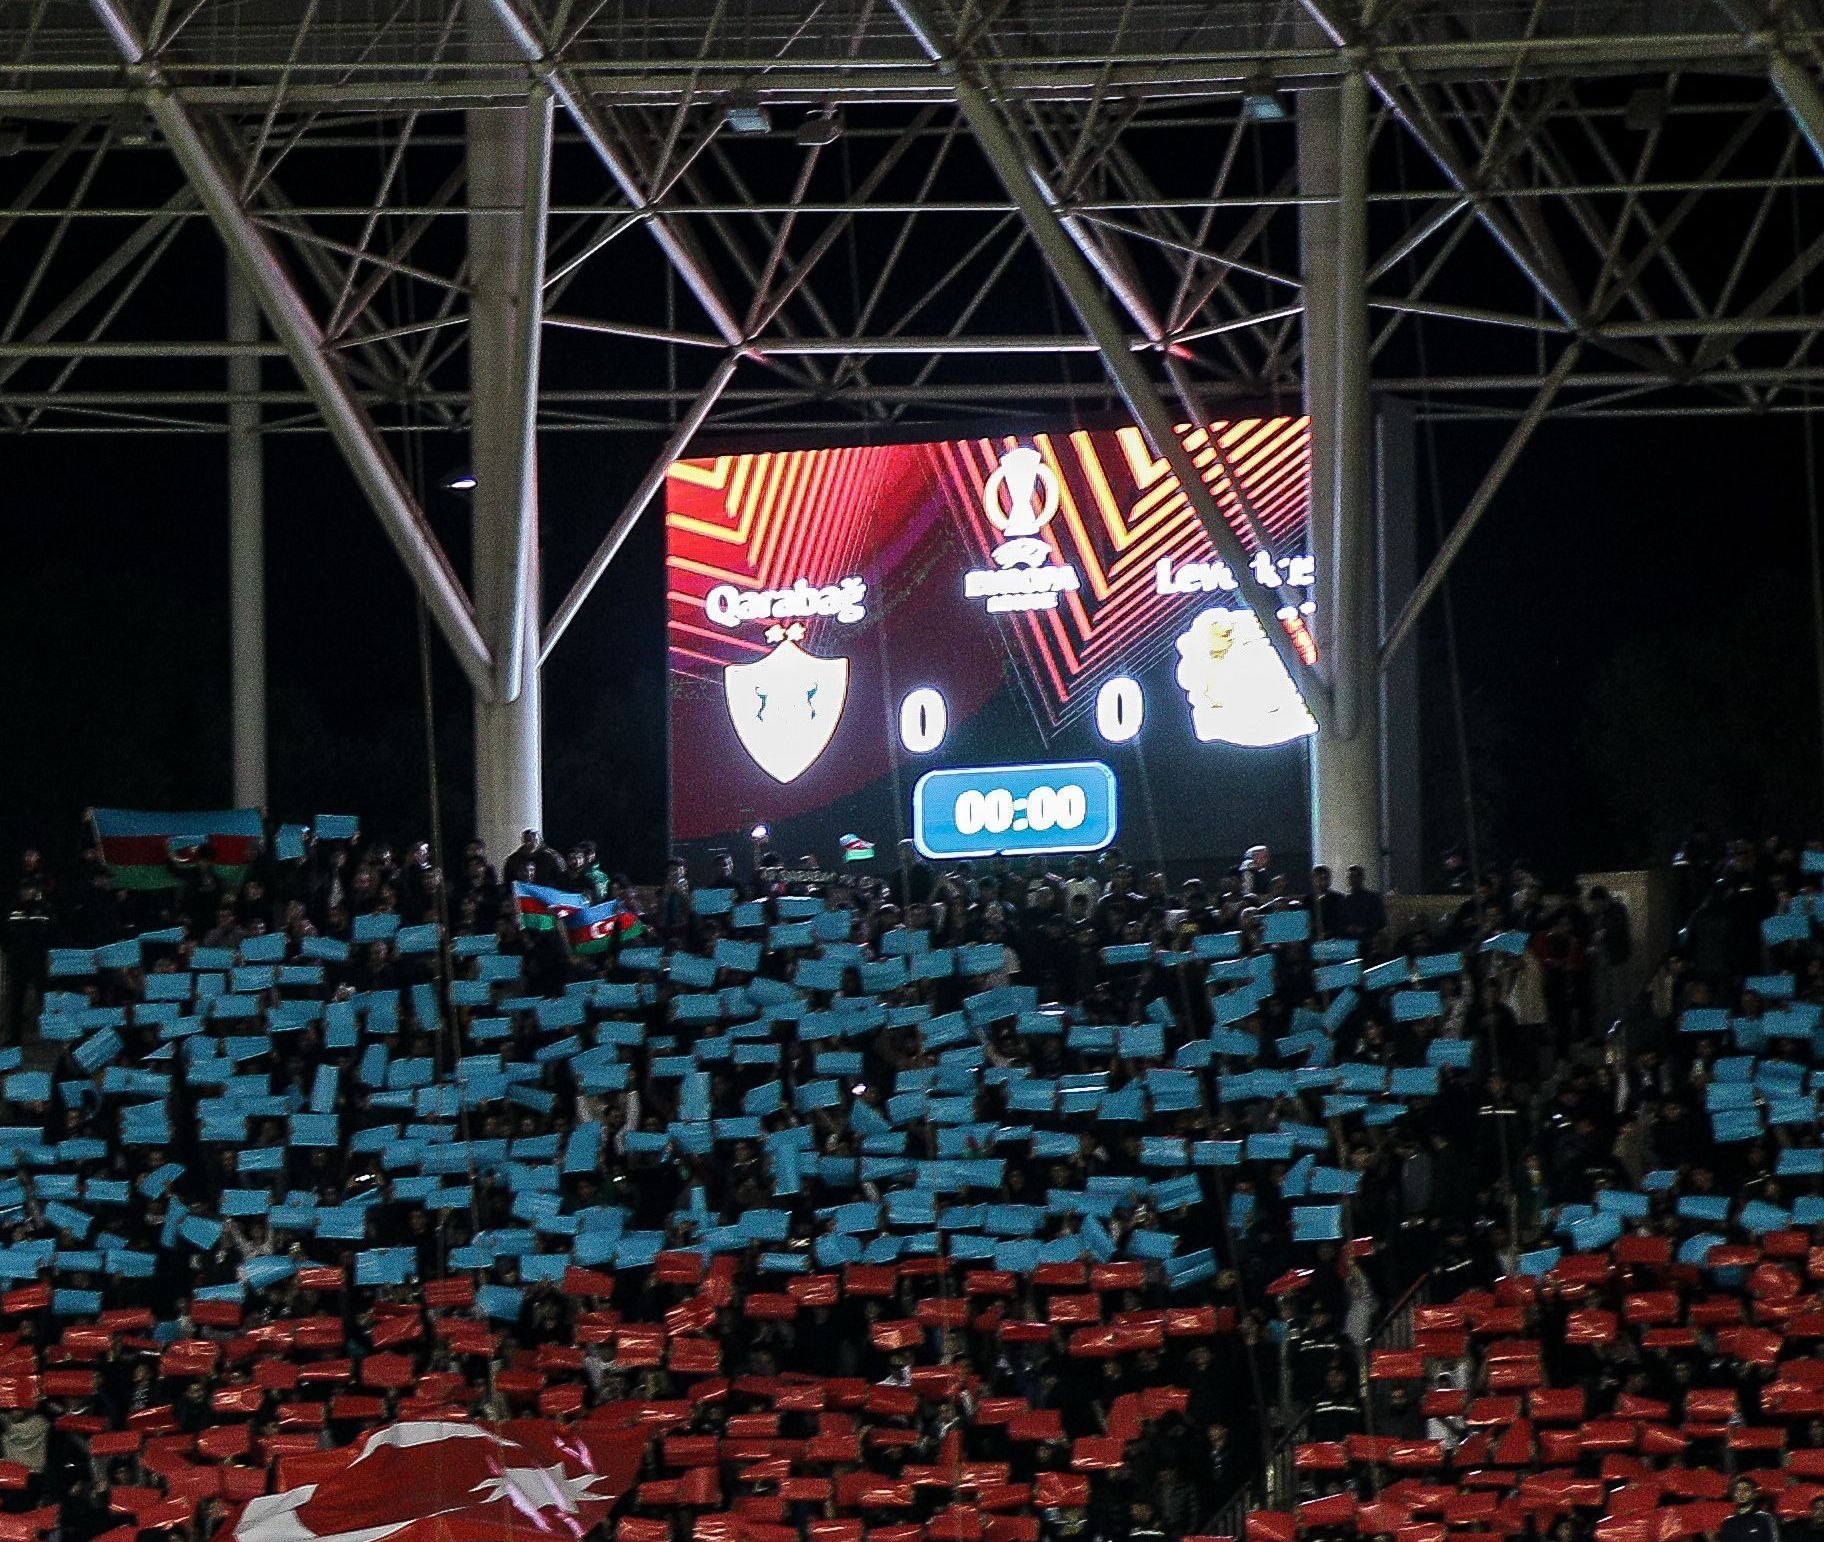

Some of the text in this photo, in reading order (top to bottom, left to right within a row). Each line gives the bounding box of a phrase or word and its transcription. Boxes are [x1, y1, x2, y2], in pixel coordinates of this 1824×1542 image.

[899, 687, 948, 753] 0
[1096, 676, 1145, 743] 0
[954, 784, 1087, 835] 00:00
